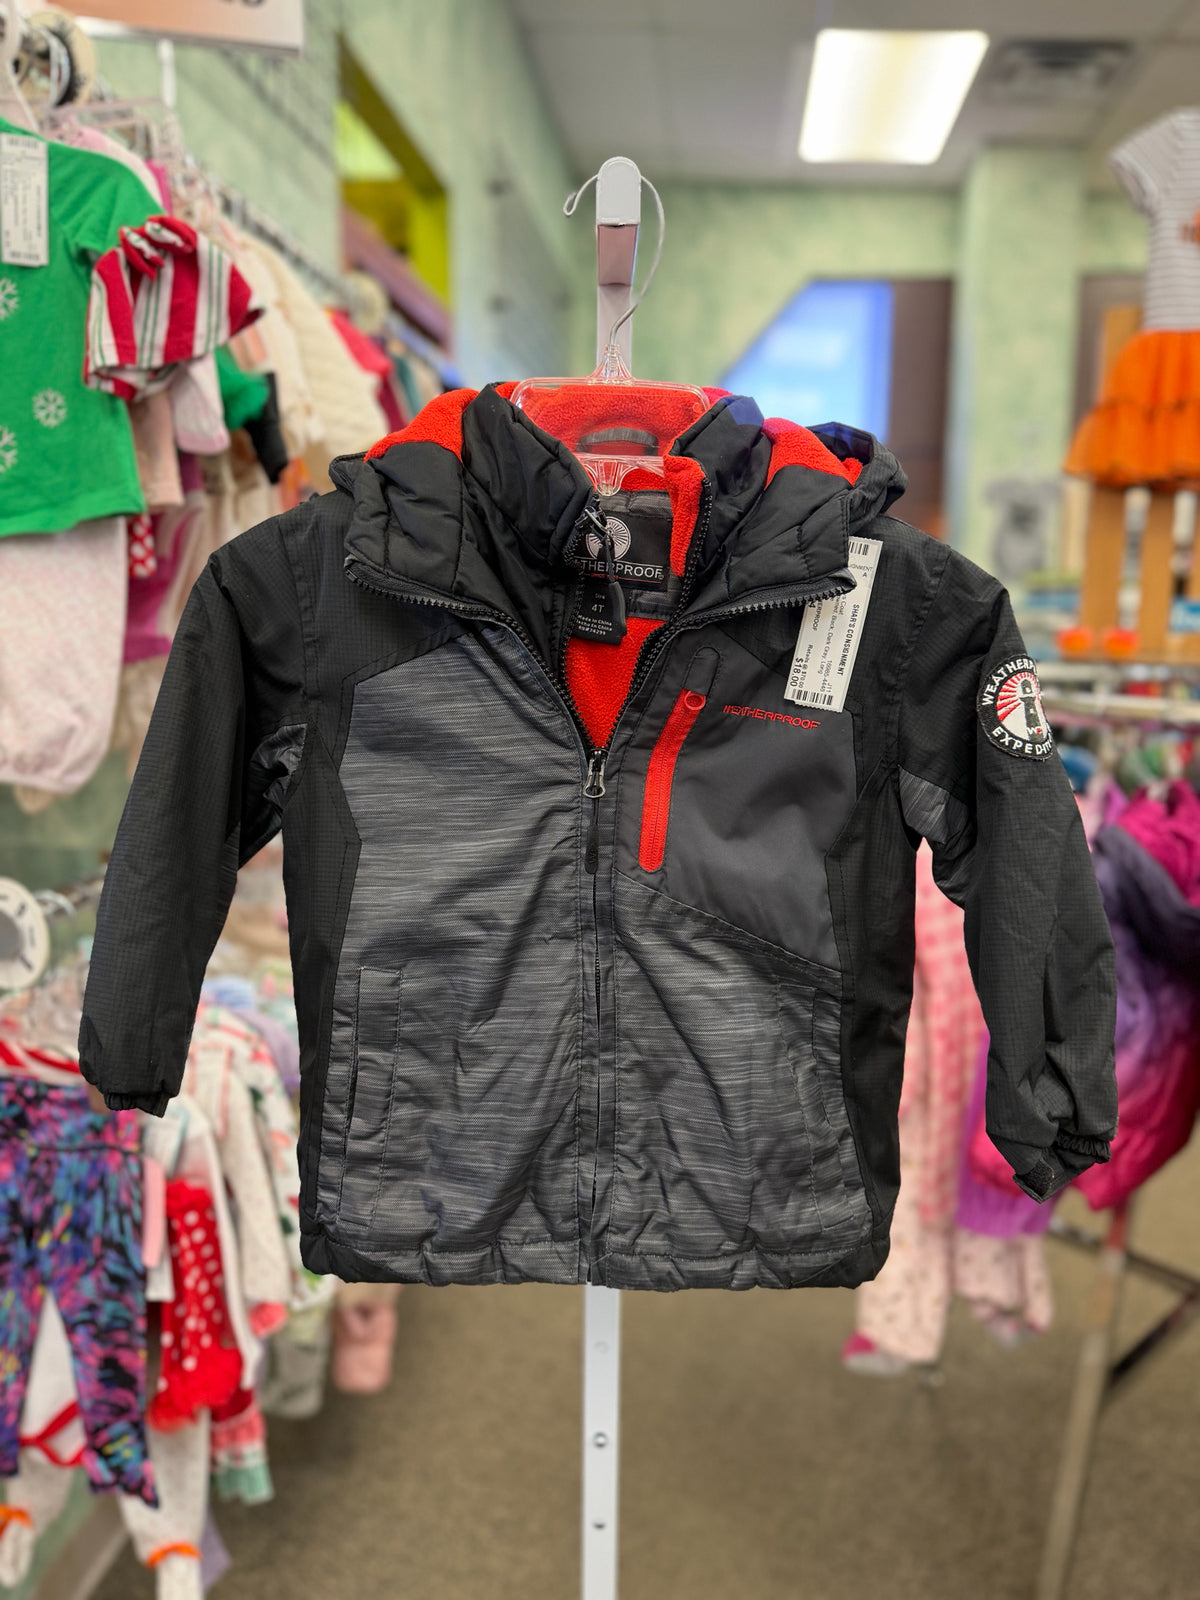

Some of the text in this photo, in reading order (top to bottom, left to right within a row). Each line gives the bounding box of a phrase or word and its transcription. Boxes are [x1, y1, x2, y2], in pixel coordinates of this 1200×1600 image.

[591, 604, 605, 613] 4T
[825, 631, 833, 645] Dark
[837, 603, 859, 675] SHAR'S CONSIGNMENT
[790, 657, 803, 687] $18.00
